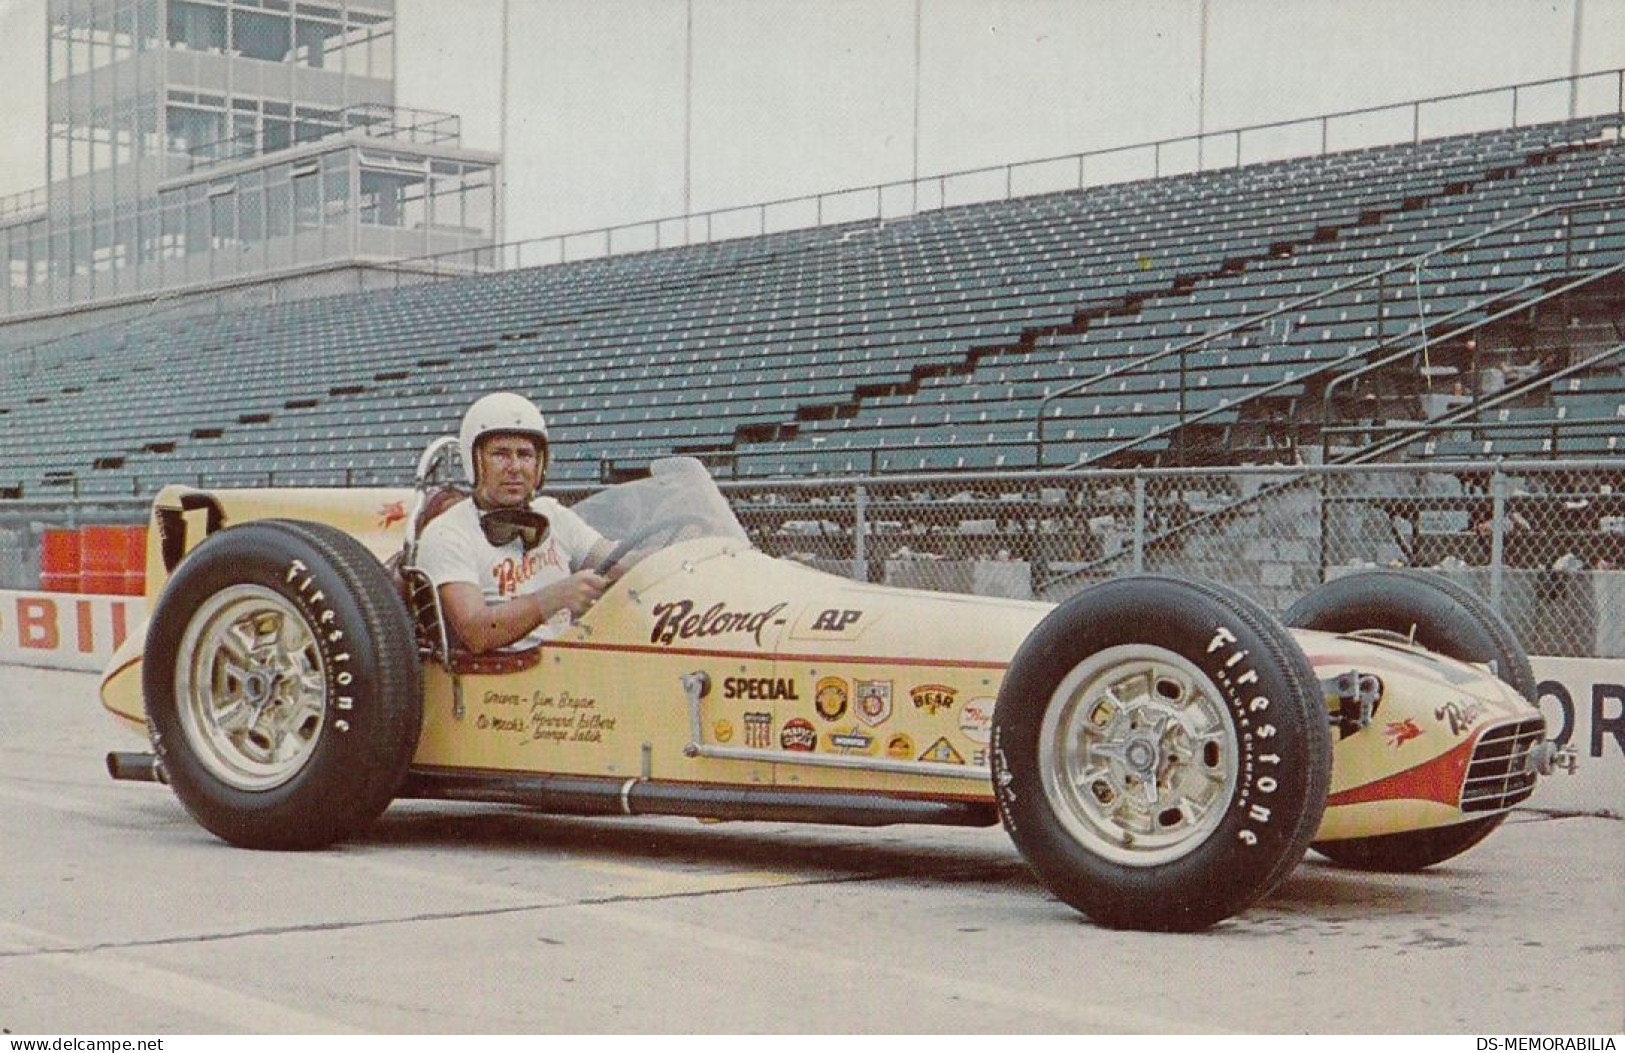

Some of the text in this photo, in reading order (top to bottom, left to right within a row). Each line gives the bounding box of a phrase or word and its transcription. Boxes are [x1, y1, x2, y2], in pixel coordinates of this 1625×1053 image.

[287, 560, 354, 733] Firestone
[811, 608, 864, 631] AP
[724, 677, 799, 700] SPECIAL
[1206, 625, 1282, 846] Firestone
